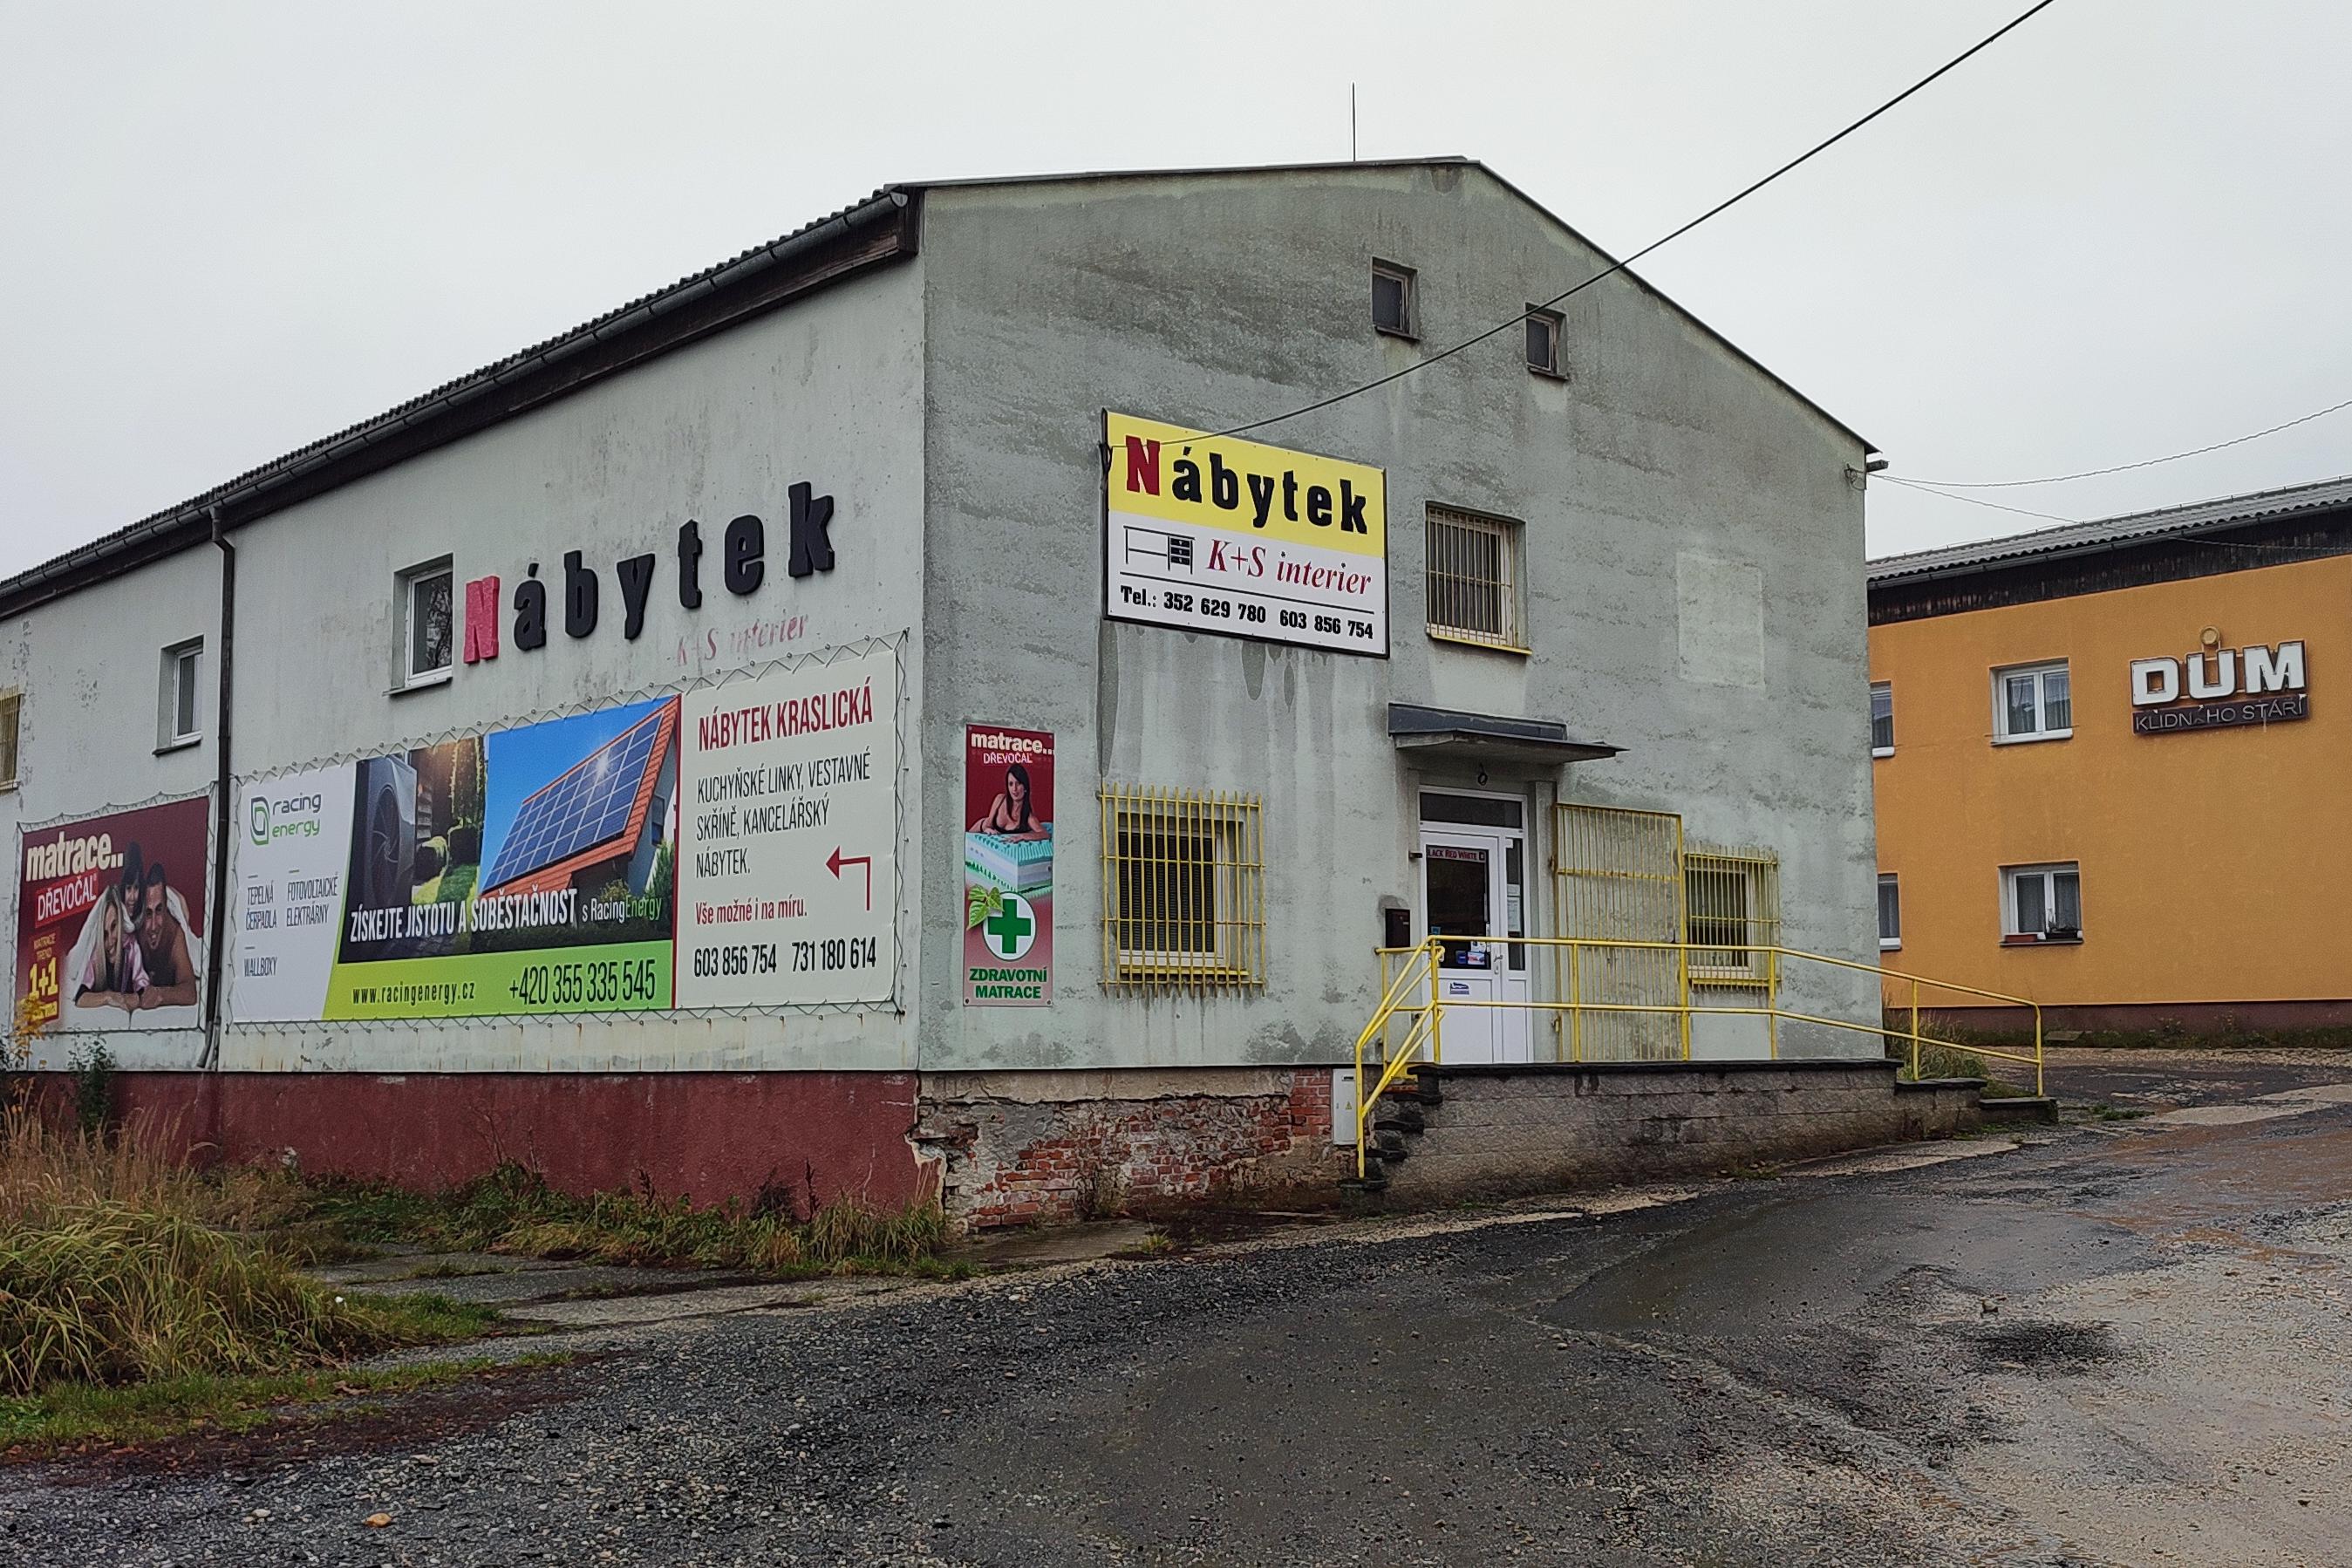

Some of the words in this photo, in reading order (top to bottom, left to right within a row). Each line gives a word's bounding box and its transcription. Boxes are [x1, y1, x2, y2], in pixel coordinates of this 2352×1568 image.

[1126, 435, 1367, 535] Nábytek
[463, 481, 835, 666] Nábytek
[1206, 538, 1266, 577] K+S
[1277, 551, 1371, 595] interier
[1120, 585, 1157, 607] Tel.:
[1163, 592, 1193, 612] 352
[1200, 598, 1231, 618] 629
[1237, 603, 1266, 624] 780
[1279, 610, 1307, 629] 603
[1314, 615, 1341, 634] 856
[1347, 620, 1374, 639] 754
[2130, 626, 2307, 706] DŮM
[699, 704, 772, 752] NÁBYTEK
[776, 676, 873, 739] KRASLICKÁ
[2136, 707, 2235, 731] KLIDNHO
[697, 762, 766, 803] KUCHYŇSKÉ
[768, 762, 804, 794] LINKY,
[808, 746, 871, 787] VESTAVNÉ
[272, 792, 321, 815] racing
[697, 805, 740, 842] SKŘÍNĚ,
[743, 792, 830, 835] KANCELÁŘSKÝ
[272, 819, 320, 838] energy
[696, 846, 751, 879] NÁBYTEK.
[247, 879, 274, 906] TEPELNÁ
[287, 871, 338, 902] FOTOVOLTAICKÉ
[245, 908, 277, 931] ČERPADLA
[286, 901, 330, 927] ELEKTRÁRNY
[350, 903, 403, 943] ZÍSKEJTE
[406, 903, 455, 937] JISTOTU
[458, 902, 467, 934] A
[471, 883, 578, 931] SOBĚSTAČNOST
[582, 906, 588, 922] s
[590, 896, 662, 924] RacingEnergy
[695, 898, 714, 925] Vše
[716, 896, 753, 924] možné
[754, 897, 760, 921] i
[761, 900, 774, 920] na
[778, 893, 808, 919] míru.
[243, 957, 277, 977] WALLBOXY
[694, 947, 719, 978] 603
[722, 945, 747, 976] 856
[752, 943, 777, 973] 754
[791, 940, 816, 972] 731
[820, 937, 846, 971] 180
[849, 936, 876, 969] 614
[29, 957, 58, 1001] 1+1
[352, 980, 476, 1006] www.racingenergy.cz
[509, 965, 548, 1006] +420
[553, 964, 583, 1004] 355
[587, 961, 617, 1002] 335
[623, 959, 656, 1000] 545
[970, 965, 1047, 982] ZDRAVOTNÍ
[975, 985, 1041, 999] MATRACE
